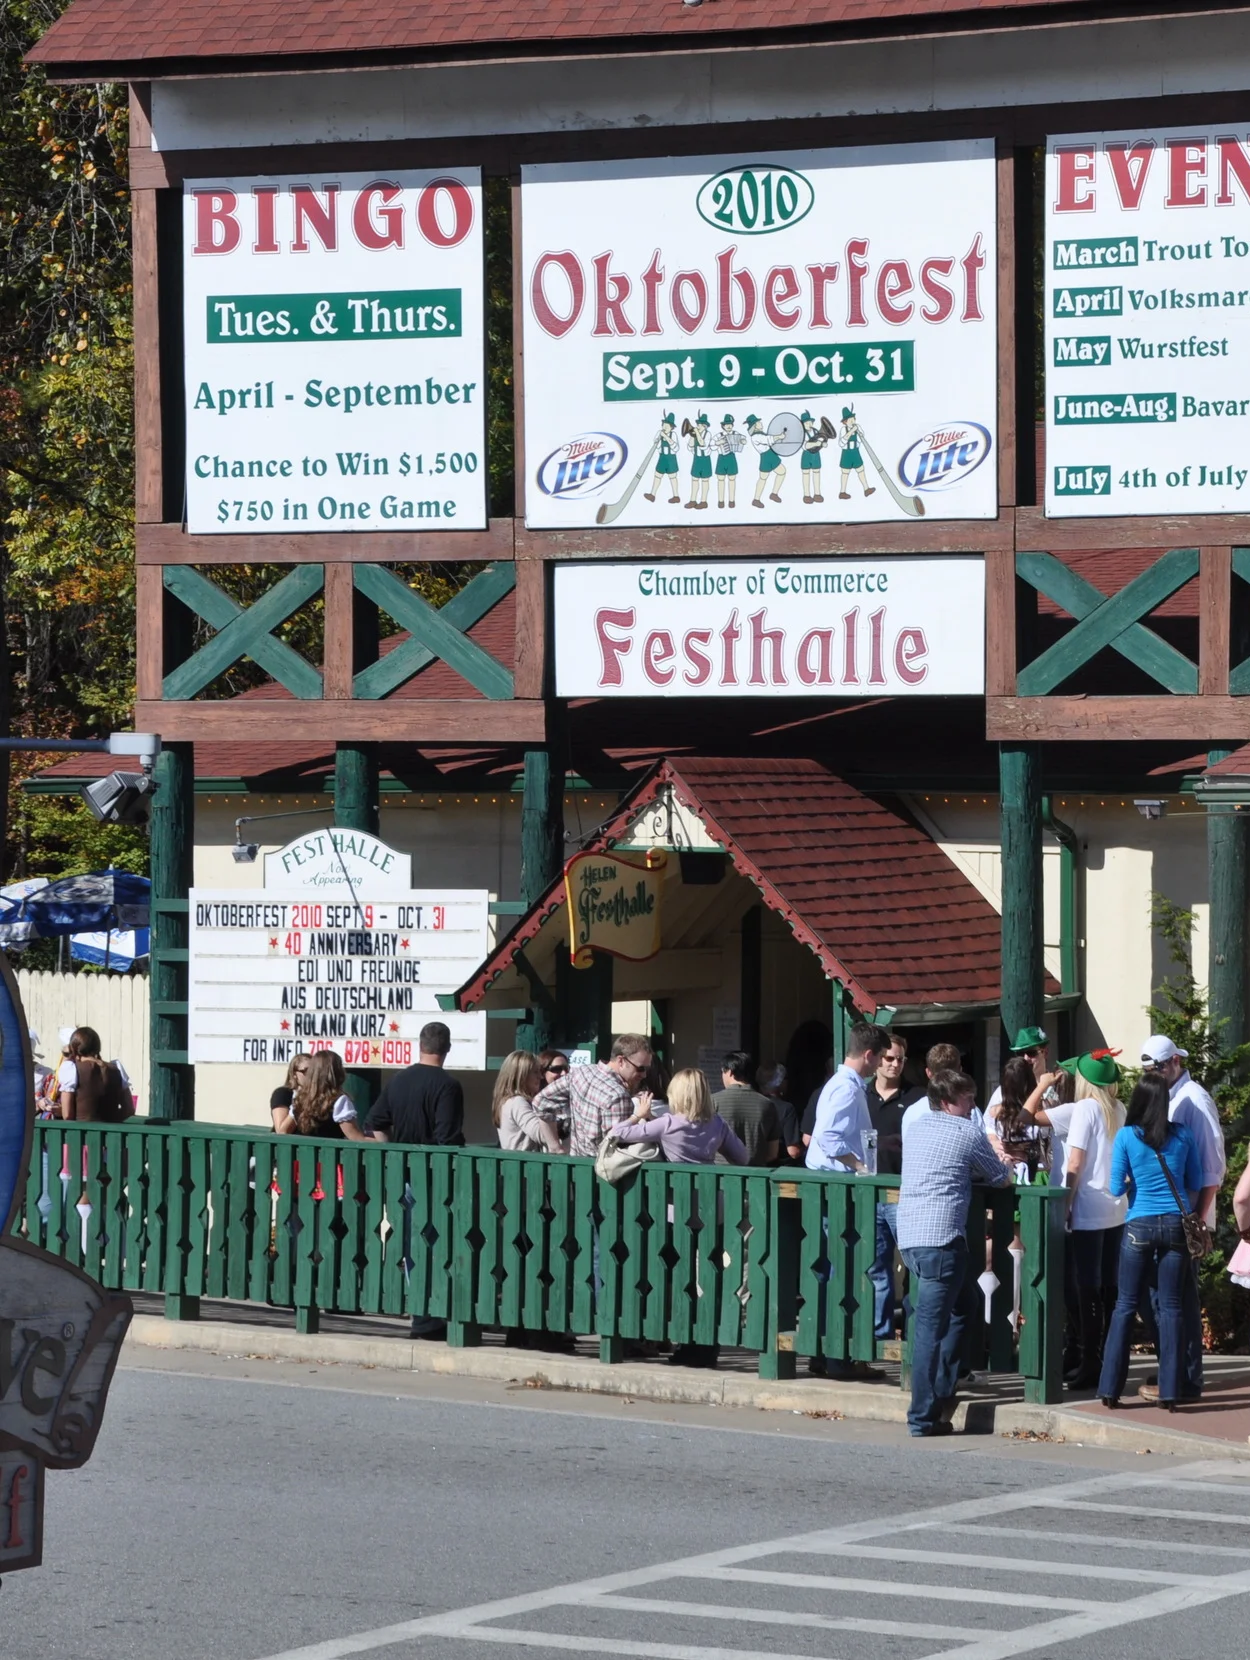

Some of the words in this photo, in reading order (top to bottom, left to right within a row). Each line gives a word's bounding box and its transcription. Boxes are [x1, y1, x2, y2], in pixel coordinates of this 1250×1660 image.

[712, 169, 798, 229] 2010
[191, 176, 475, 257] BINGO
[1055, 241, 1136, 267] March
[1143, 239, 1213, 262] Trout
[531, 231, 986, 340] Oktoberfest
[1055, 288, 1121, 316] April
[214, 301, 299, 336] Tues.
[310, 300, 338, 334] &
[348, 298, 455, 333] Thurs.
[1055, 338, 1109, 364] May
[1117, 335, 1229, 360] Wurstfest
[605, 354, 705, 397] Sept.
[719, 354, 741, 387] 9
[775, 347, 853, 385] Oct.
[865, 348, 904, 382] 31
[193, 380, 275, 415] April
[303, 376, 476, 413] September
[1056, 394, 1175, 421] June-Aug.
[561, 441, 604, 457] Miller
[924, 430, 968, 448] Miller
[194, 455, 293, 478] Chance
[302, 455, 328, 477] to
[335, 452, 389, 475] Win
[398, 451, 478, 477] $1,500
[551, 451, 615, 495] Lite
[912, 440, 979, 488] Lite
[1055, 468, 1109, 494] July
[1119, 468, 1157, 489] 4th
[1165, 465, 1191, 487] of
[1198, 465, 1248, 490] July
[217, 499, 274, 524] $750
[283, 497, 307, 520] in
[317, 496, 371, 520] One
[380, 495, 457, 519] Game
[638, 568, 737, 596] Chamber
[746, 568, 765, 596] of
[774, 566, 888, 595] Commerce
[594, 605, 929, 688] Festhalle
[282, 835, 325, 874] FEST
[333, 834, 395, 874] HALLE
[580, 865, 617, 887] HELEN
[196, 904, 287, 928] OKTOBERFEST
[292, 904, 322, 929] 2010
[365, 905, 373, 928] 9
[398, 906, 427, 929] OCT.
[433, 906, 444, 929] 31
[578, 880, 654, 944] Festhalle
[285, 932, 301, 955] 40
[309, 932, 398, 956] ANNIVERSARY
[298, 959, 318, 982] EDI
[327, 959, 352, 982] UND
[361, 960, 420, 983] FREUNDE
[282, 986, 306, 1009] AUS
[316, 987, 413, 1010] DEUTSCHLAND
[295, 1013, 346, 1036] ROLAND
[351, 1014, 385, 1037] KURZ
[243, 1039, 267, 1061] FOR
[273, 1039, 303, 1062] INFO
[382, 1041, 411, 1064] 1908
